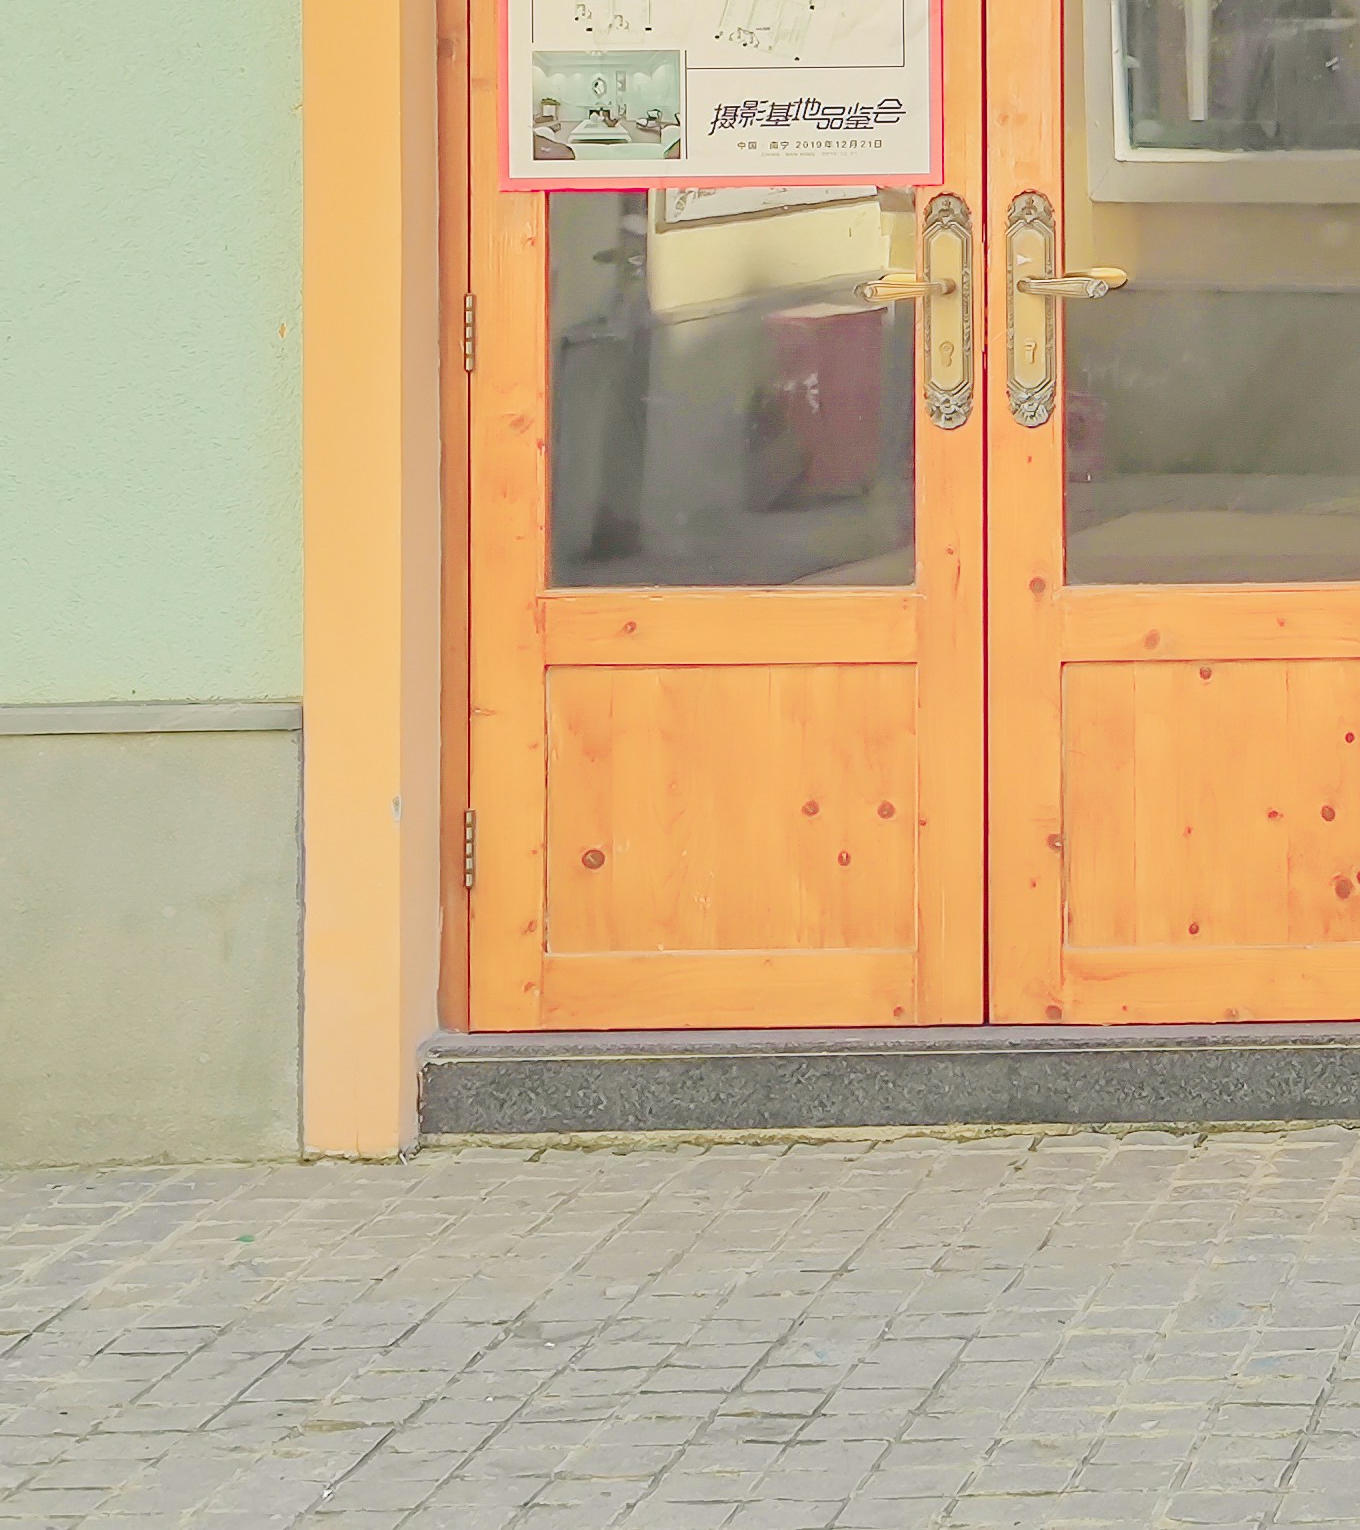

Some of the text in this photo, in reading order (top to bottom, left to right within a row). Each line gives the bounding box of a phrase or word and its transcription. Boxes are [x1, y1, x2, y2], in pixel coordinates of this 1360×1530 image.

[707, 97, 907, 136] 摄影基地品鉴会
